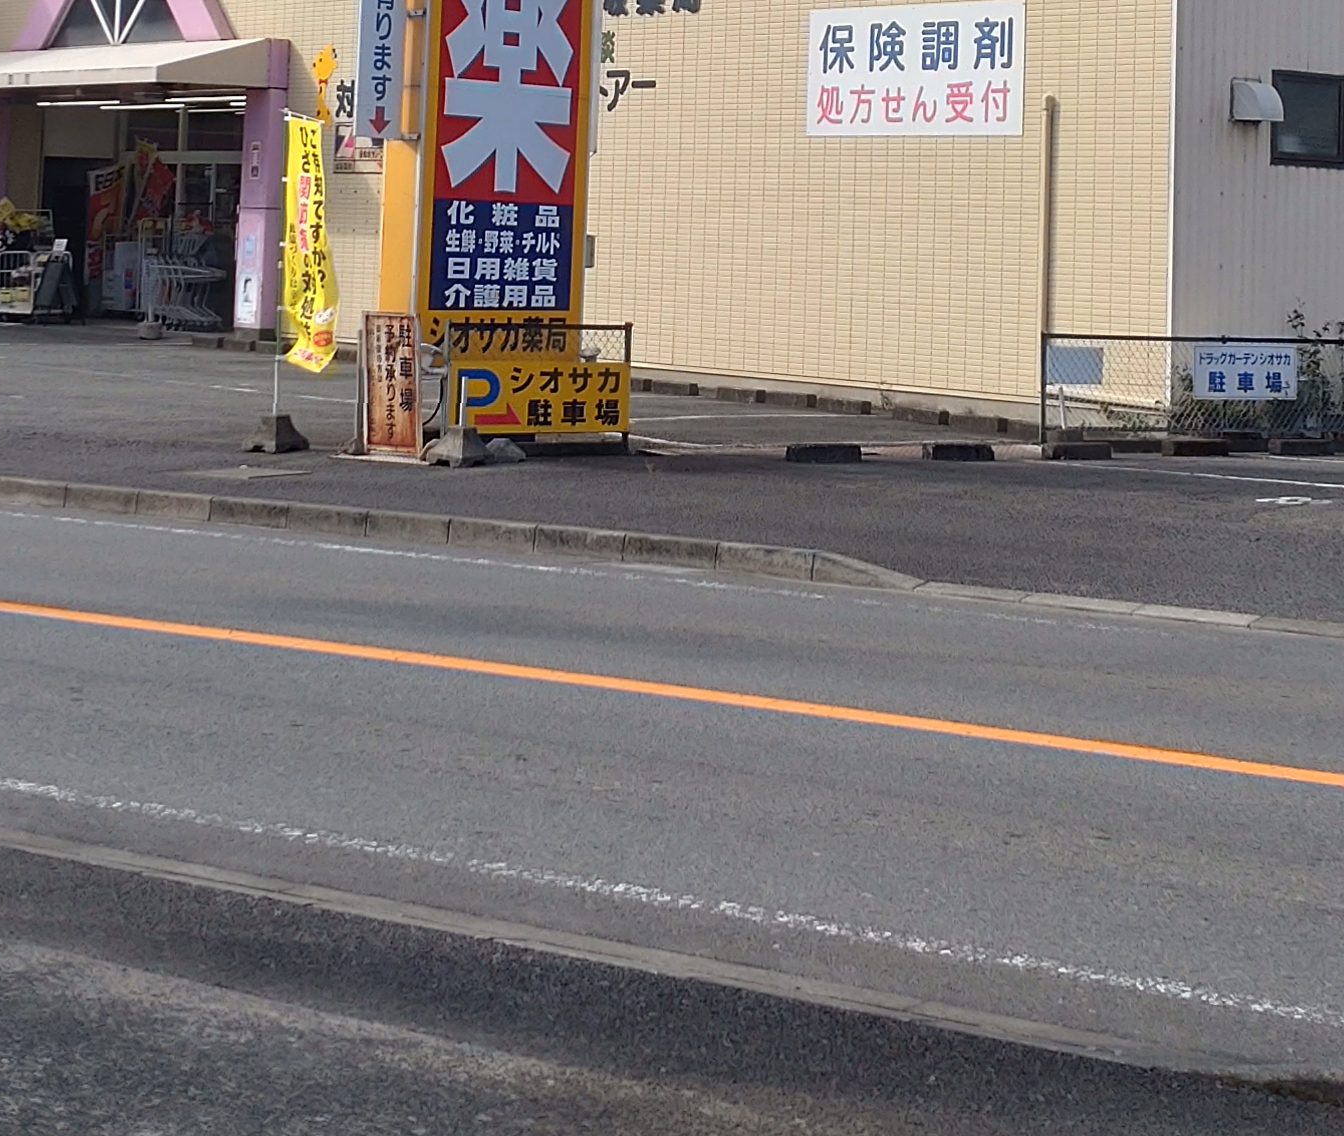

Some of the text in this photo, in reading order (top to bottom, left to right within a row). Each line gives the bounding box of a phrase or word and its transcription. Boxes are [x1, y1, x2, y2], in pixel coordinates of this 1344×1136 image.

[818, 16, 1015, 75] 保険調剤
[816, 80, 1012, 125] 処方せん受付
[446, 200, 561, 228] 化粧品
[446, 256, 559, 282] 日用雑貨
[444, 283, 557, 308] 介護用品
[429, 316, 568, 354] シオサカ薬局
[384, 324, 397, 440] 予約承ります
[398, 324, 413, 413] 駐車場
[510, 367, 621, 395] シオサカ
[1208, 370, 1283, 394] 駐車場
[526, 399, 620, 428] 駐車場
